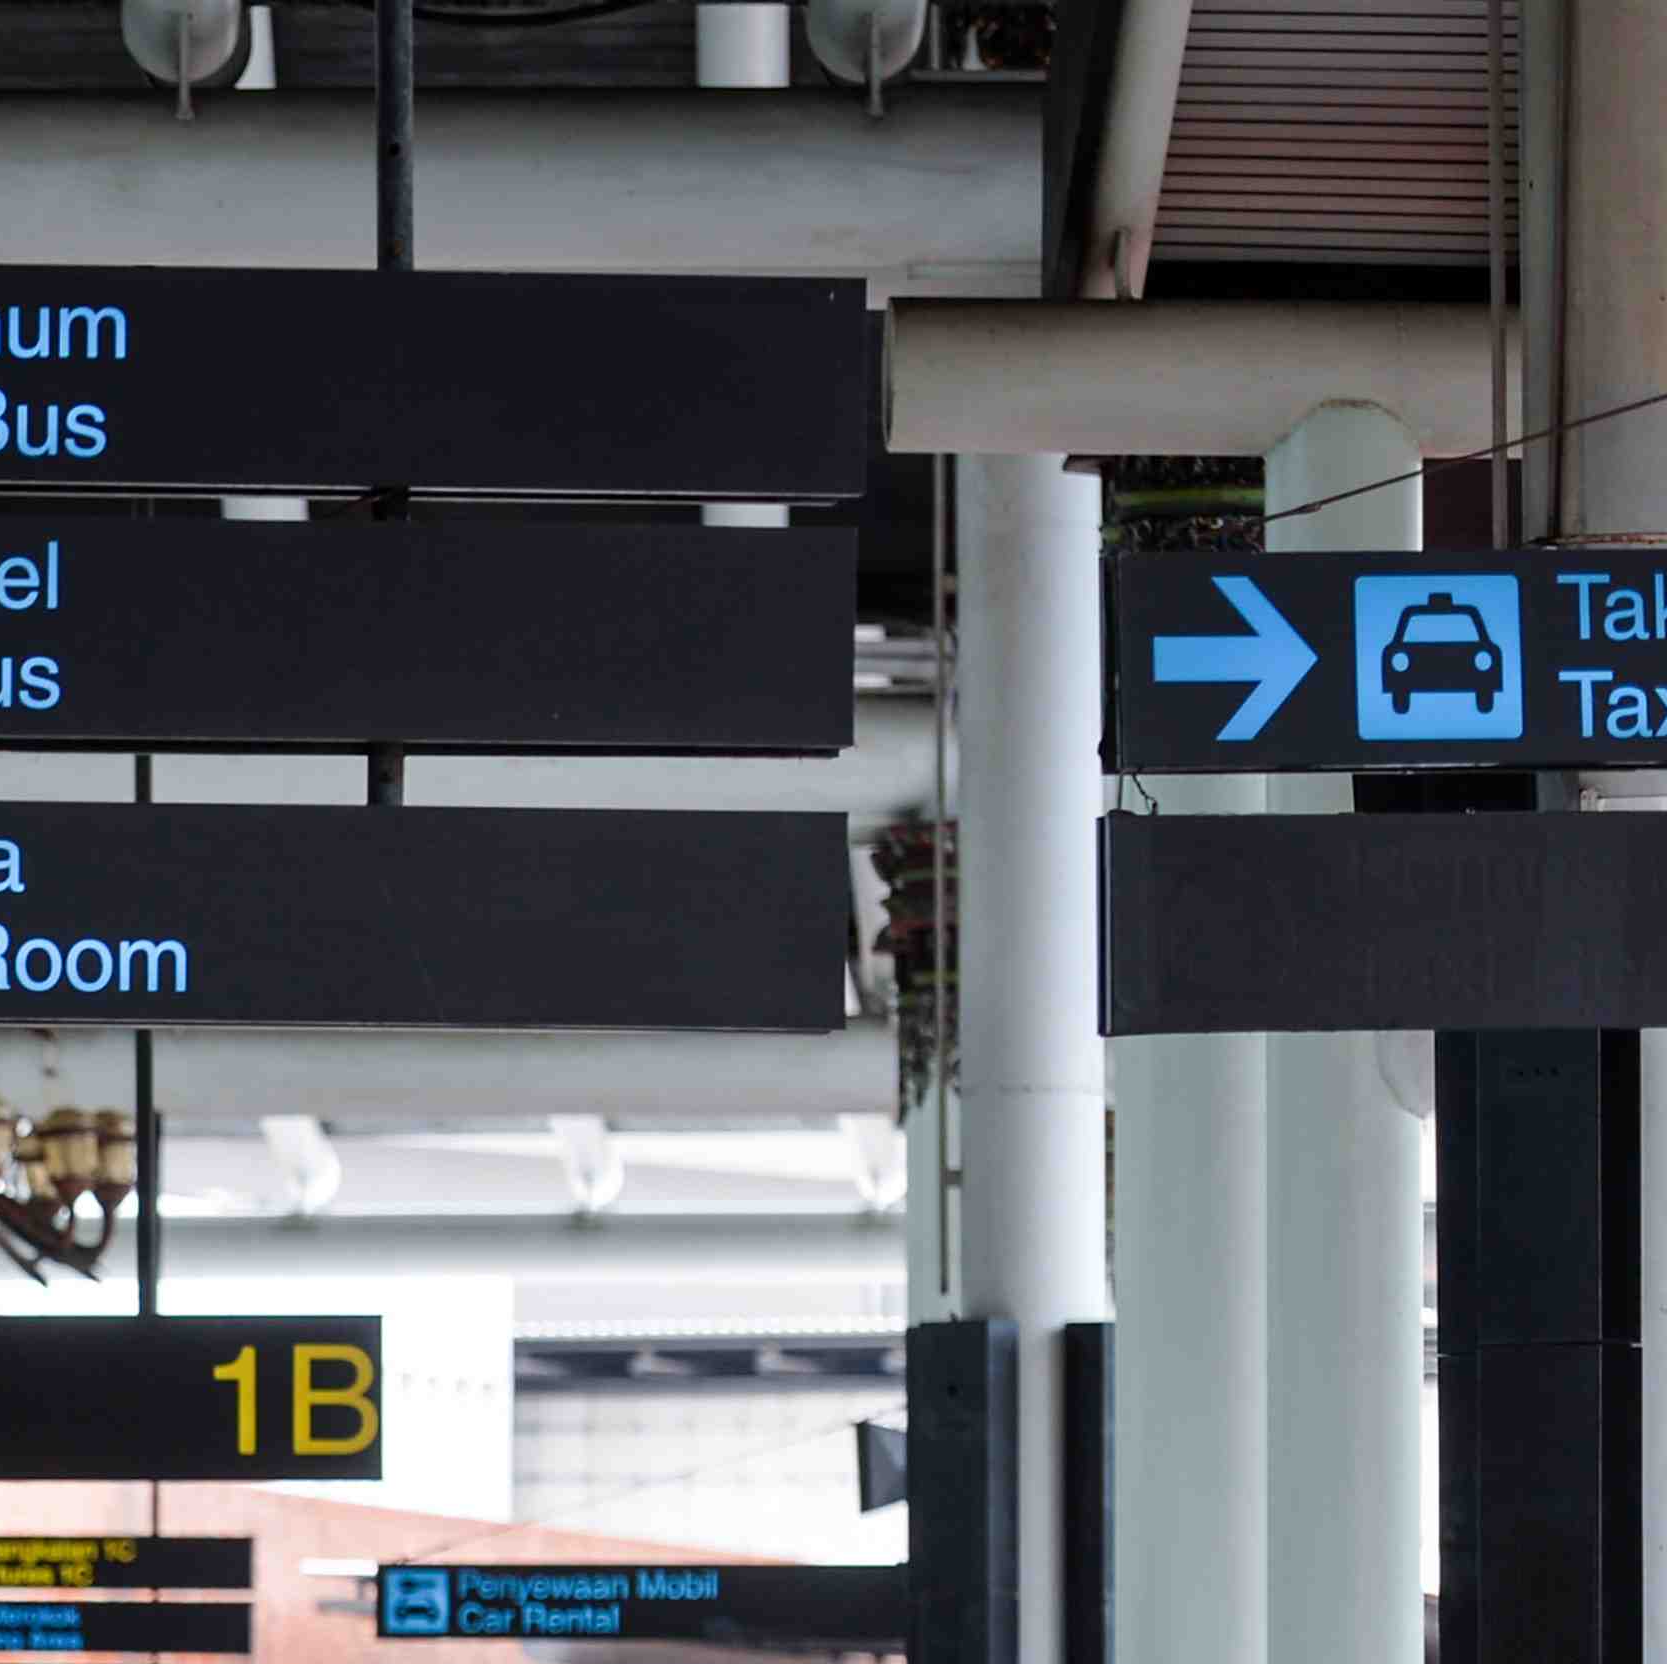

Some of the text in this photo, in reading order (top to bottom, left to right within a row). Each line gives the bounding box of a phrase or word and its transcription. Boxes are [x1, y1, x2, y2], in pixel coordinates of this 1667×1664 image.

[213, 1343, 379, 1456] 1B
[457, 1569, 719, 1611] Penyewaan Mobil
[457, 1604, 621, 1634] Car Rental
